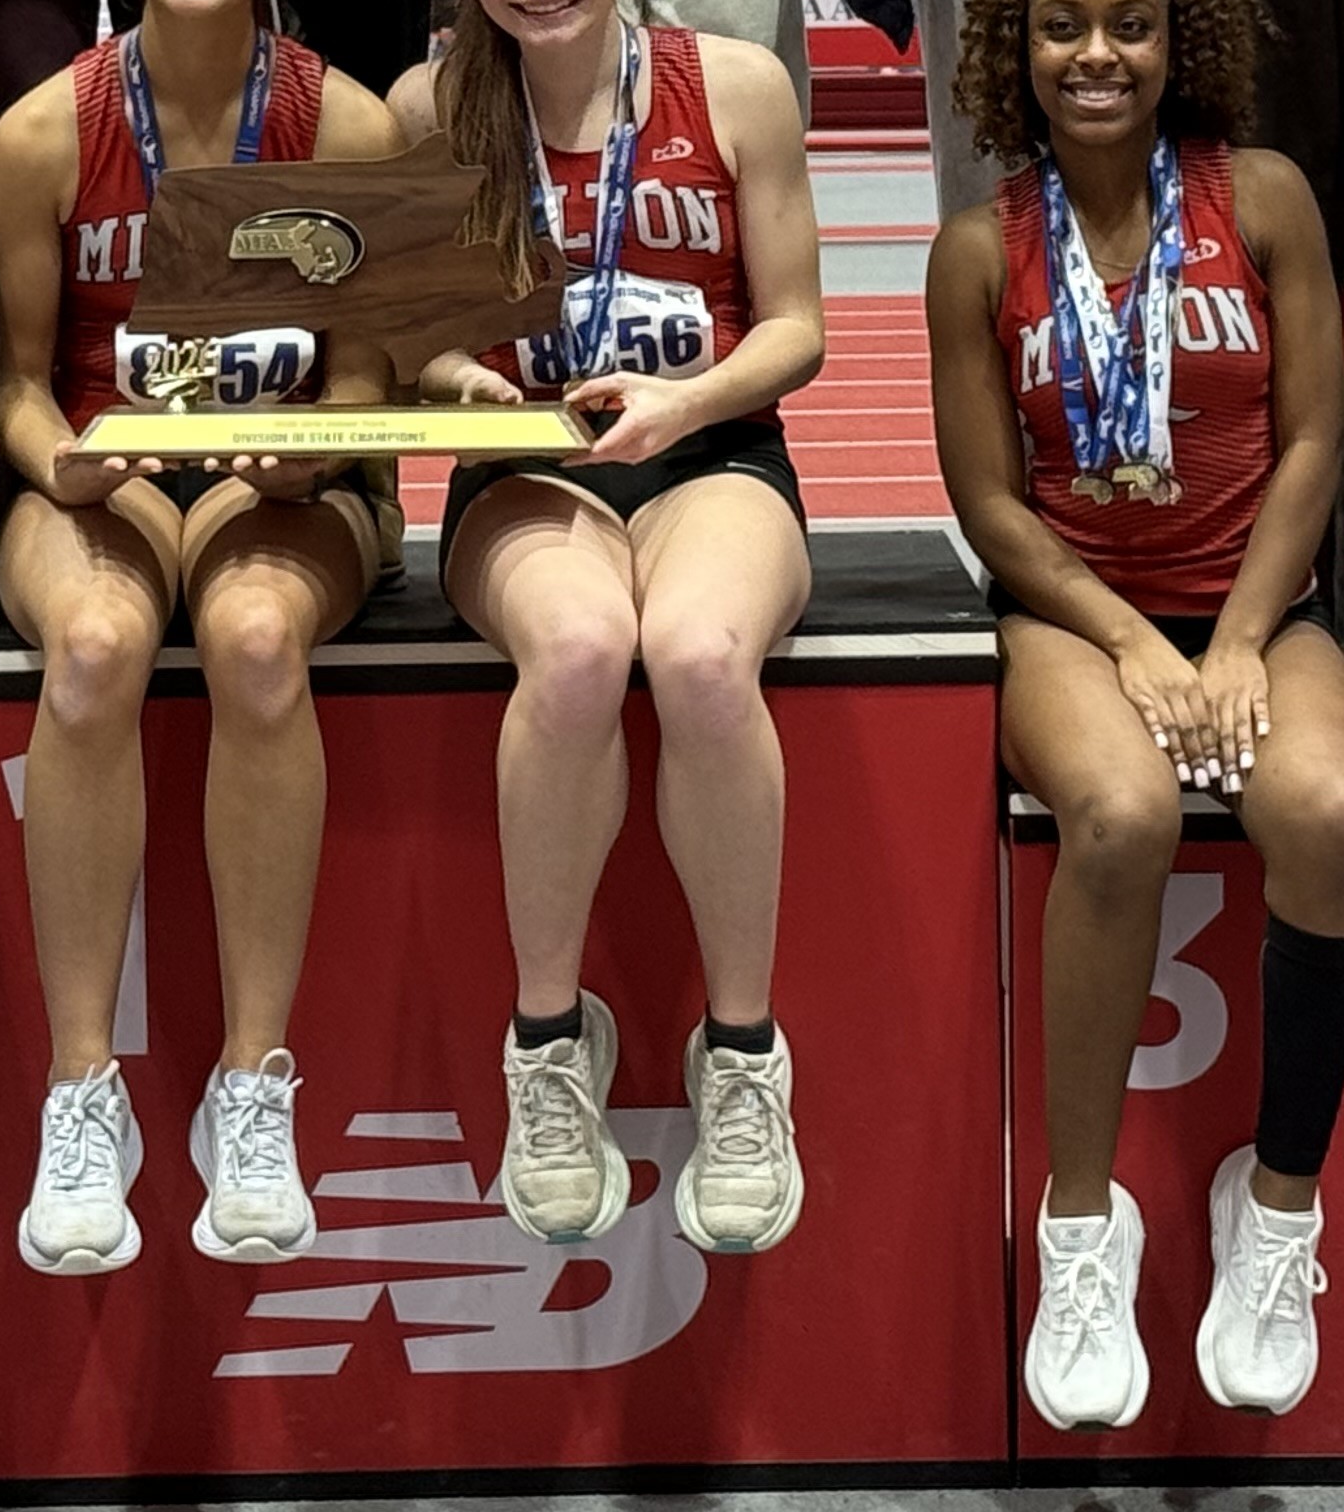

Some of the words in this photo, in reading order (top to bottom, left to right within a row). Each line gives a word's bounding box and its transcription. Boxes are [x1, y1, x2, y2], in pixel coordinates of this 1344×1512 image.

[236, 233, 302, 252] MIAA
[129, 341, 300, 405] 854
[528, 313, 703, 385] 856
